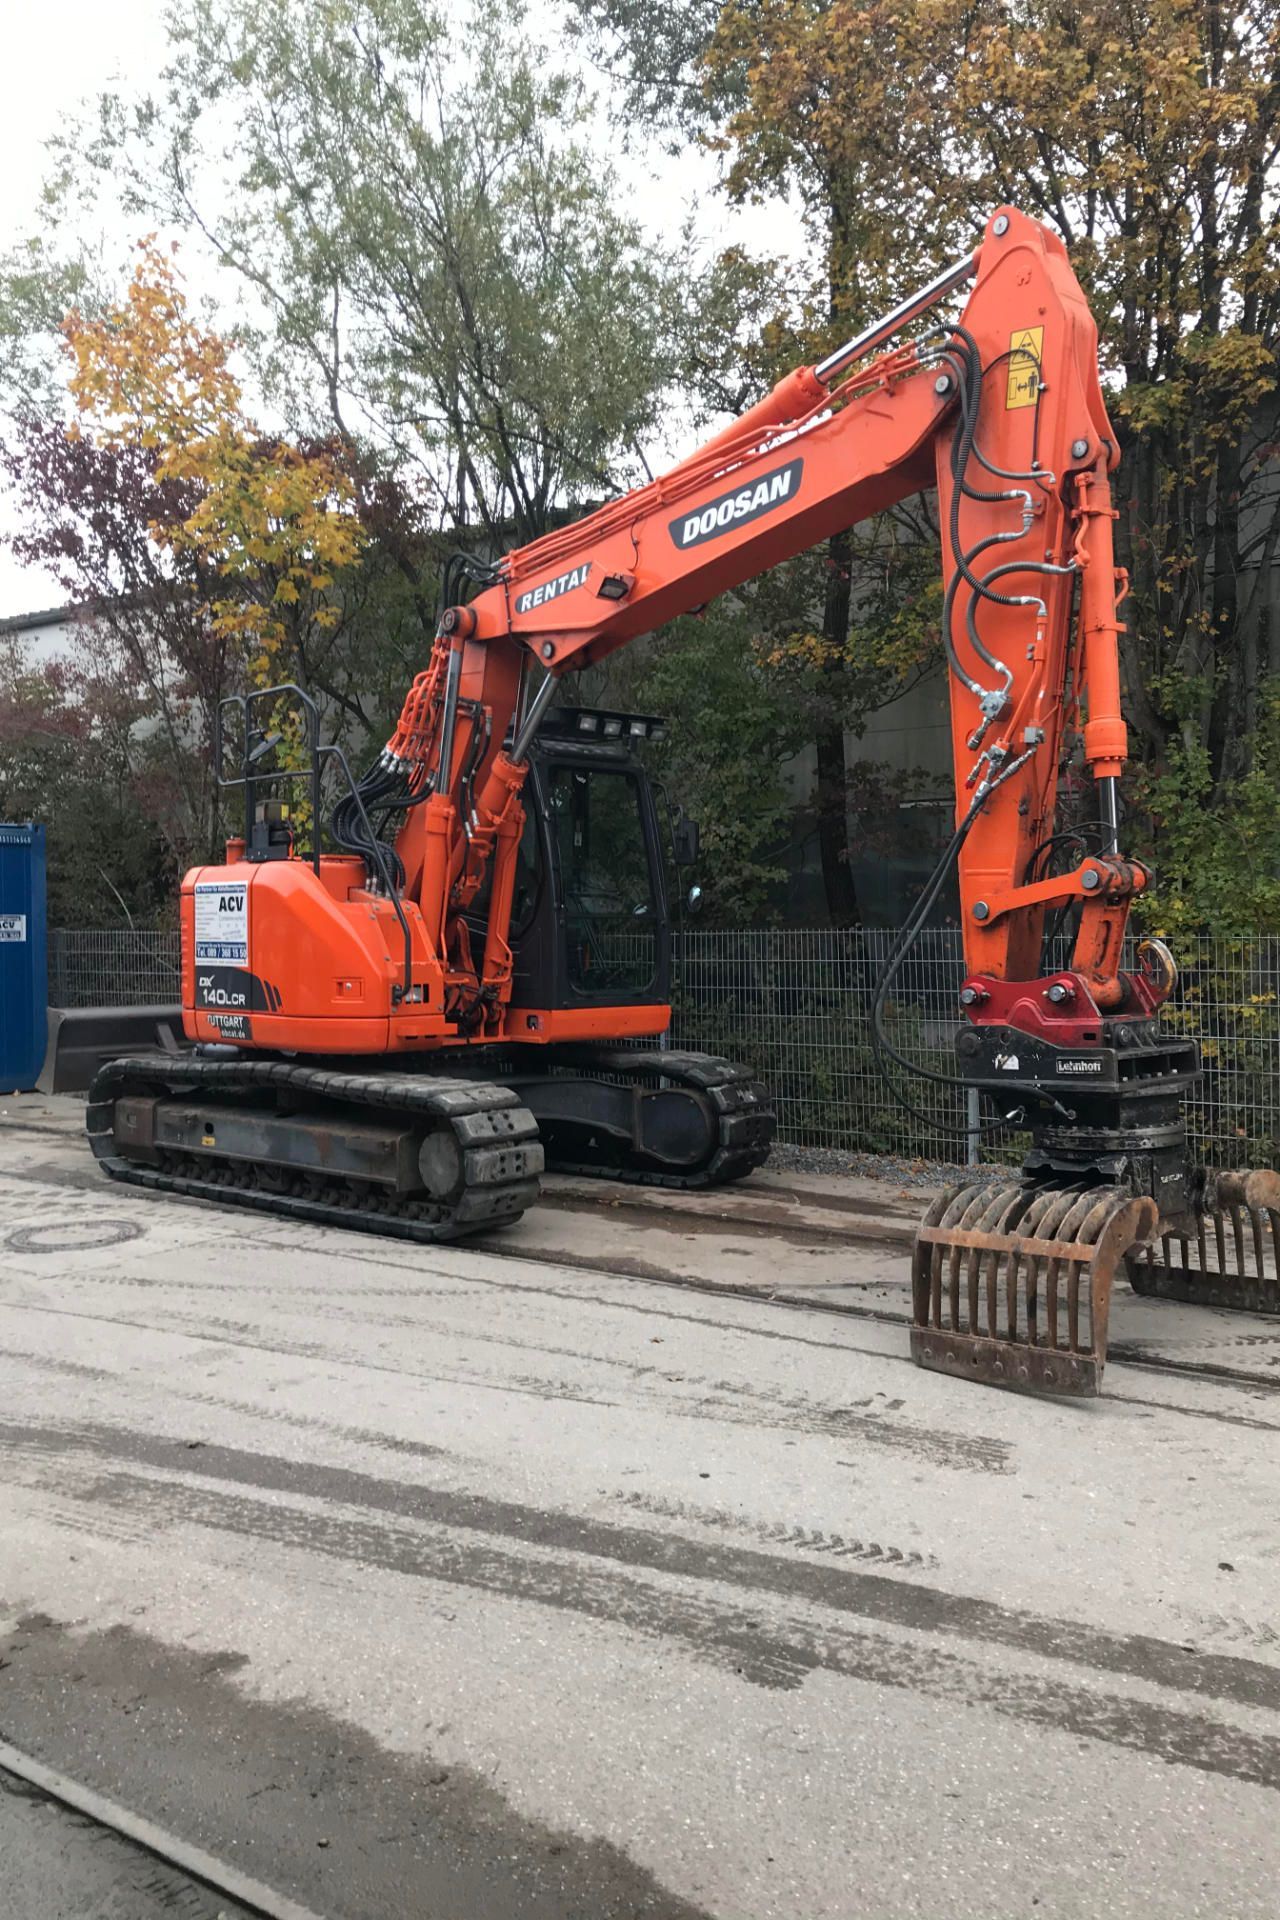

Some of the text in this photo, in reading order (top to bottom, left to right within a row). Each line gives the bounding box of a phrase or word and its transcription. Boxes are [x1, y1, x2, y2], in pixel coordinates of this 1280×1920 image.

[682, 469, 792, 545] DOOSAN
[219, 896, 244, 912] ACV
[199, 975, 215, 987] DX
[203, 989, 246, 1005] 140LCR
